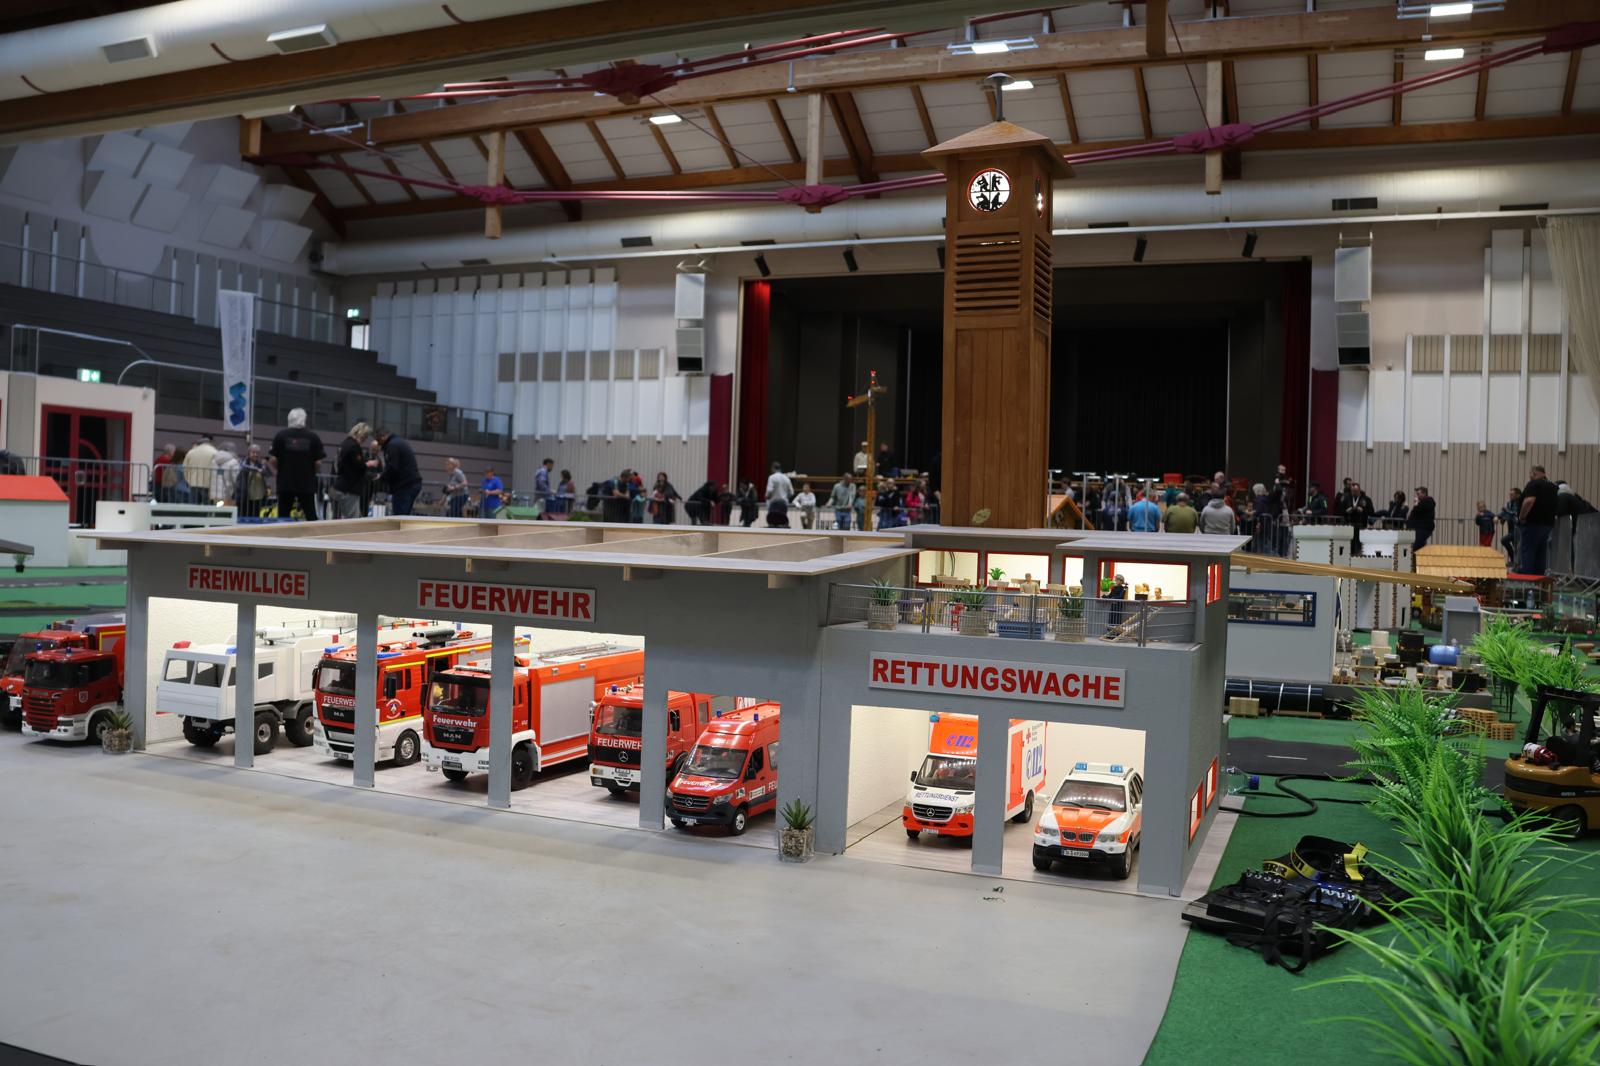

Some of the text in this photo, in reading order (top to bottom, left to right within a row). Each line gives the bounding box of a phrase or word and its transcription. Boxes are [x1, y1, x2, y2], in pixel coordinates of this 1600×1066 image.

[189, 567, 305, 596] FREIWILLIGE
[419, 583, 591, 619] FEUERWEHR
[872, 659, 1121, 700] RETTUNGSWACHE
[433, 715, 478, 727] Feuerwehr
